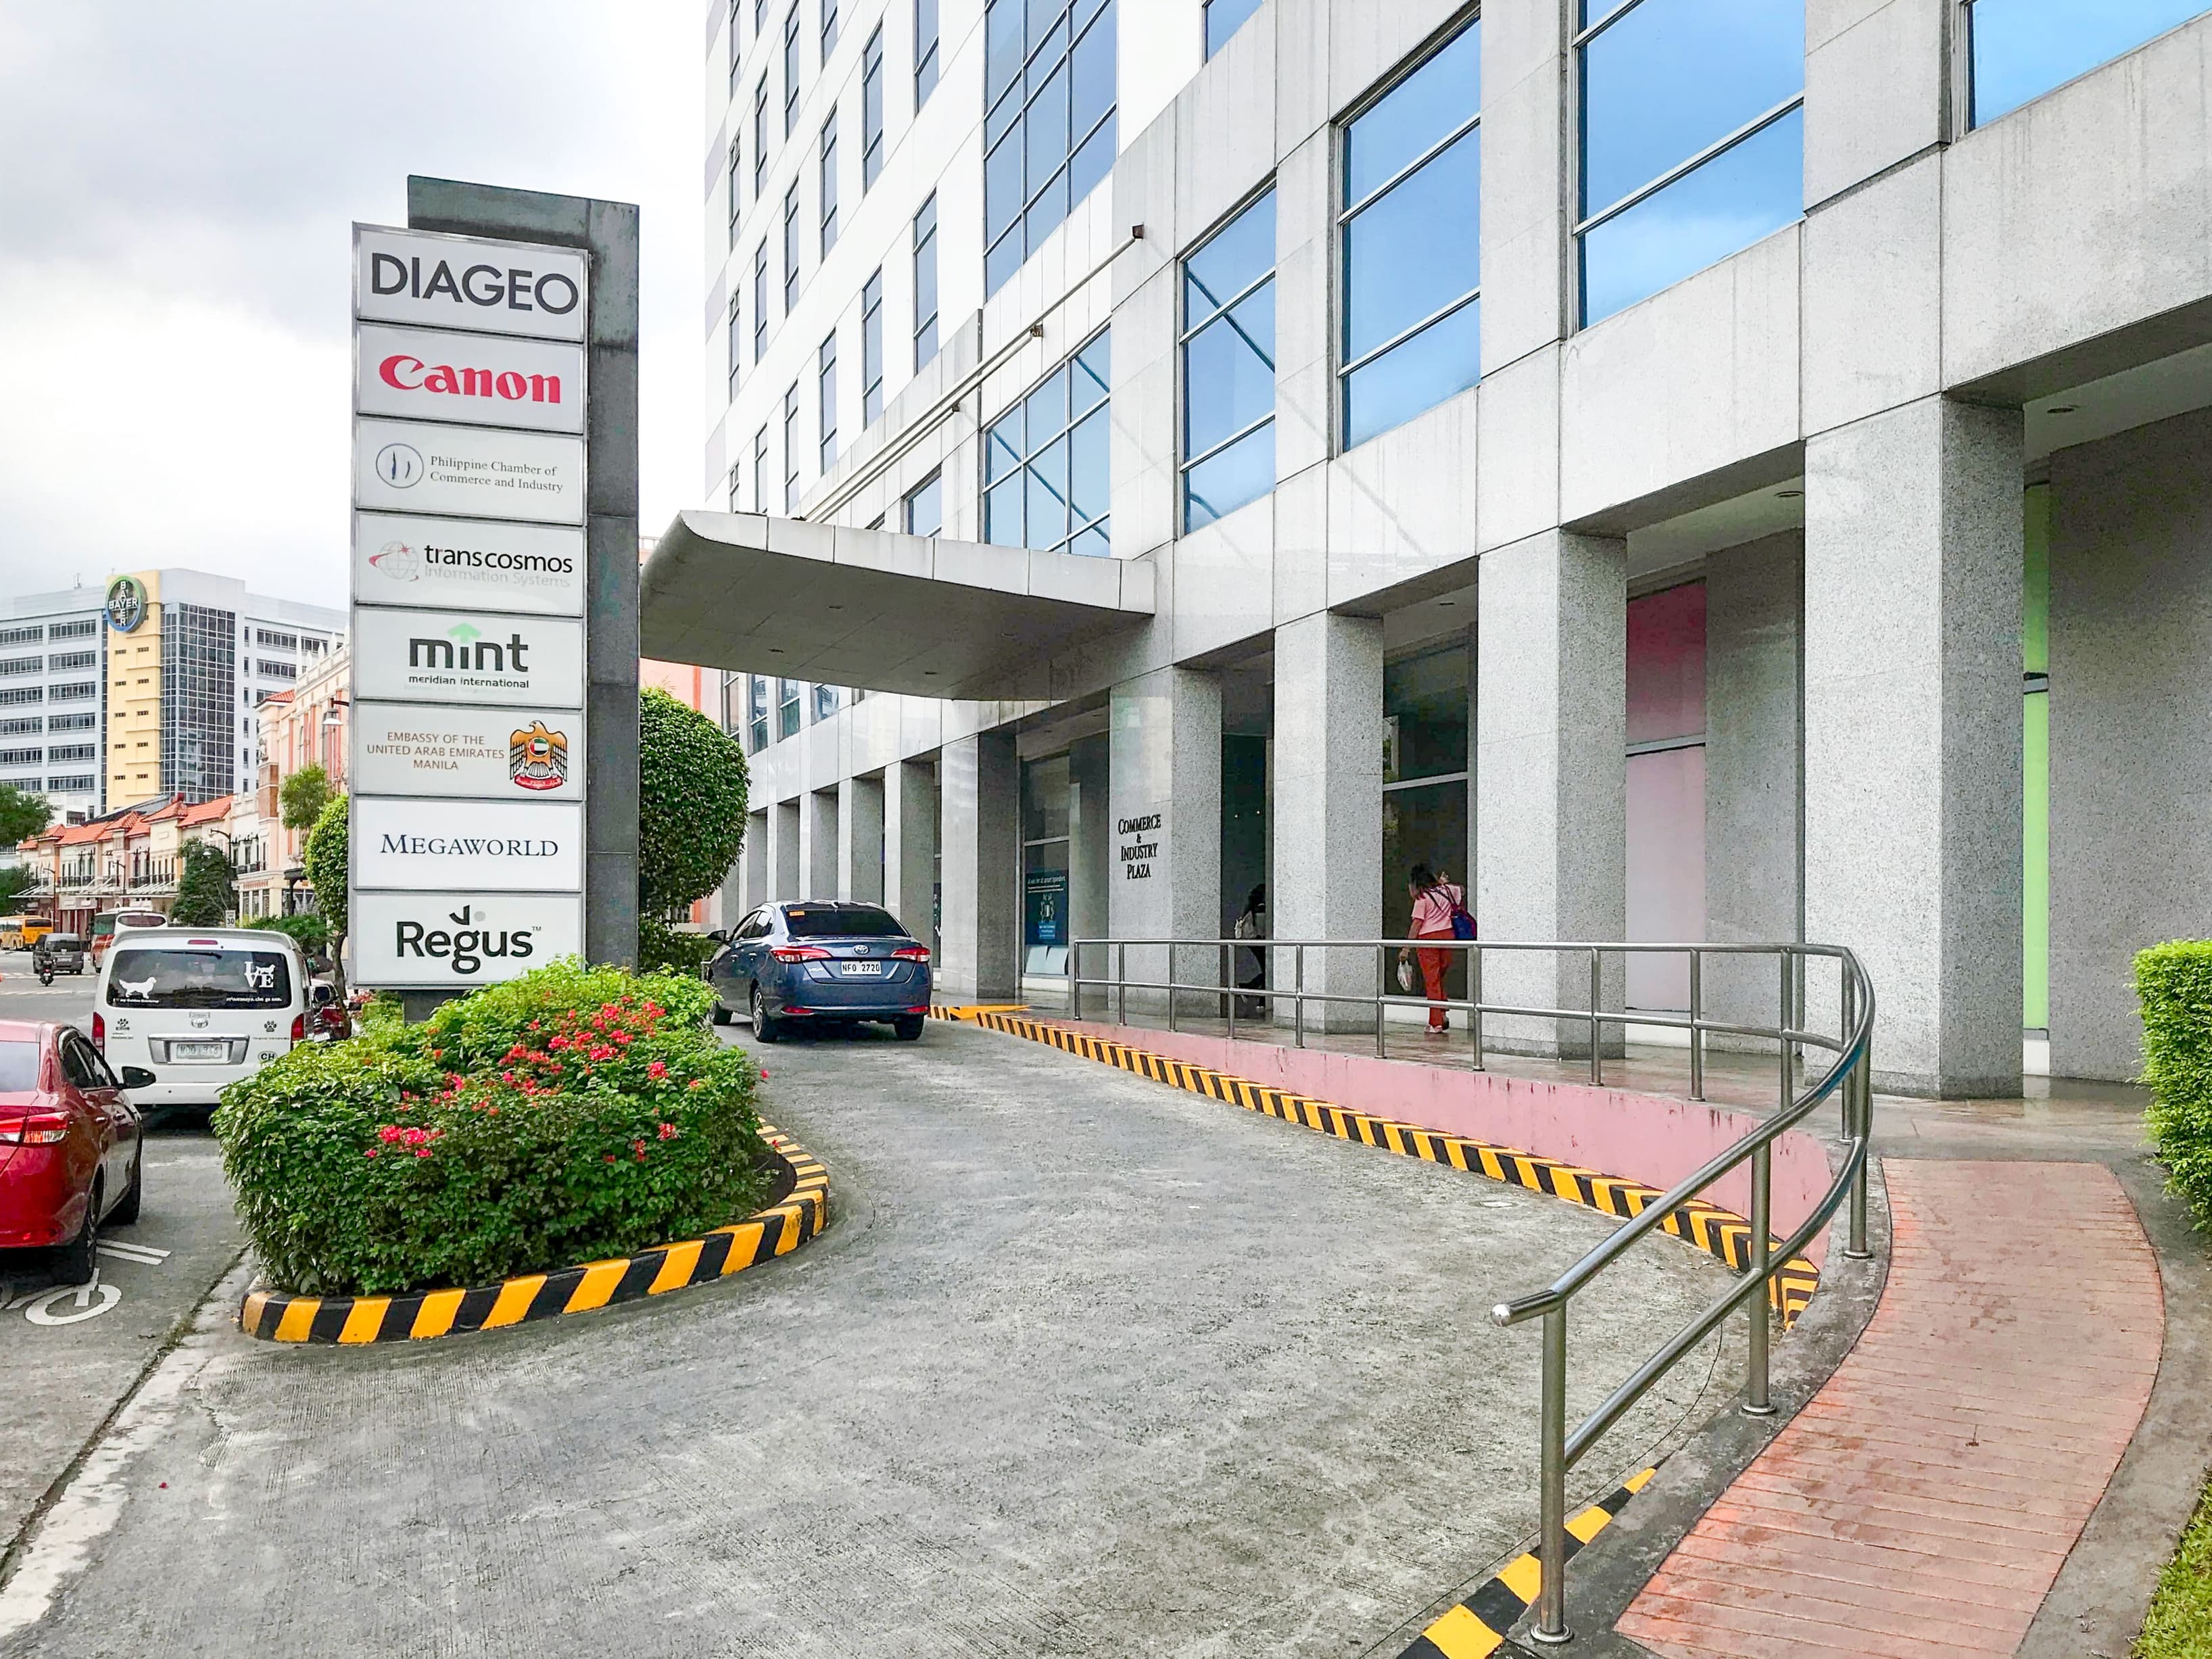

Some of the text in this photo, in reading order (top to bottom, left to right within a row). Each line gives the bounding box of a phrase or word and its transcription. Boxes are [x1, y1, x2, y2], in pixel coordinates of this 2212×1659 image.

[372, 252, 579, 314] DIAGEO
[379, 355, 560, 404] Canon
[431, 456, 558, 476] Philippine Chamber of
[431, 471, 563, 494] Commerce and Industry
[424, 544, 573, 573] transcosmos
[425, 565, 570, 588] Information Systems
[109, 598, 137, 609] BAYER
[410, 632, 529, 673] mint
[408, 675, 529, 688] meridian international
[387, 731, 485, 745] EMBASSY OF THE
[367, 744, 504, 759] UNITED ARAB EMIRATES
[413, 759, 458, 770] MANILA
[1118, 814, 1161, 834] COMMERCE
[380, 834, 558, 857] MEGAWORLD
[1136, 834, 1141, 843] &
[1121, 842, 1158, 861] INDUSTRY
[1127, 863, 1151, 880] PLAZA
[396, 905, 533, 974] Regus
[861, 963, 880, 971] 2720
[261, 1053, 274, 1061] CH
